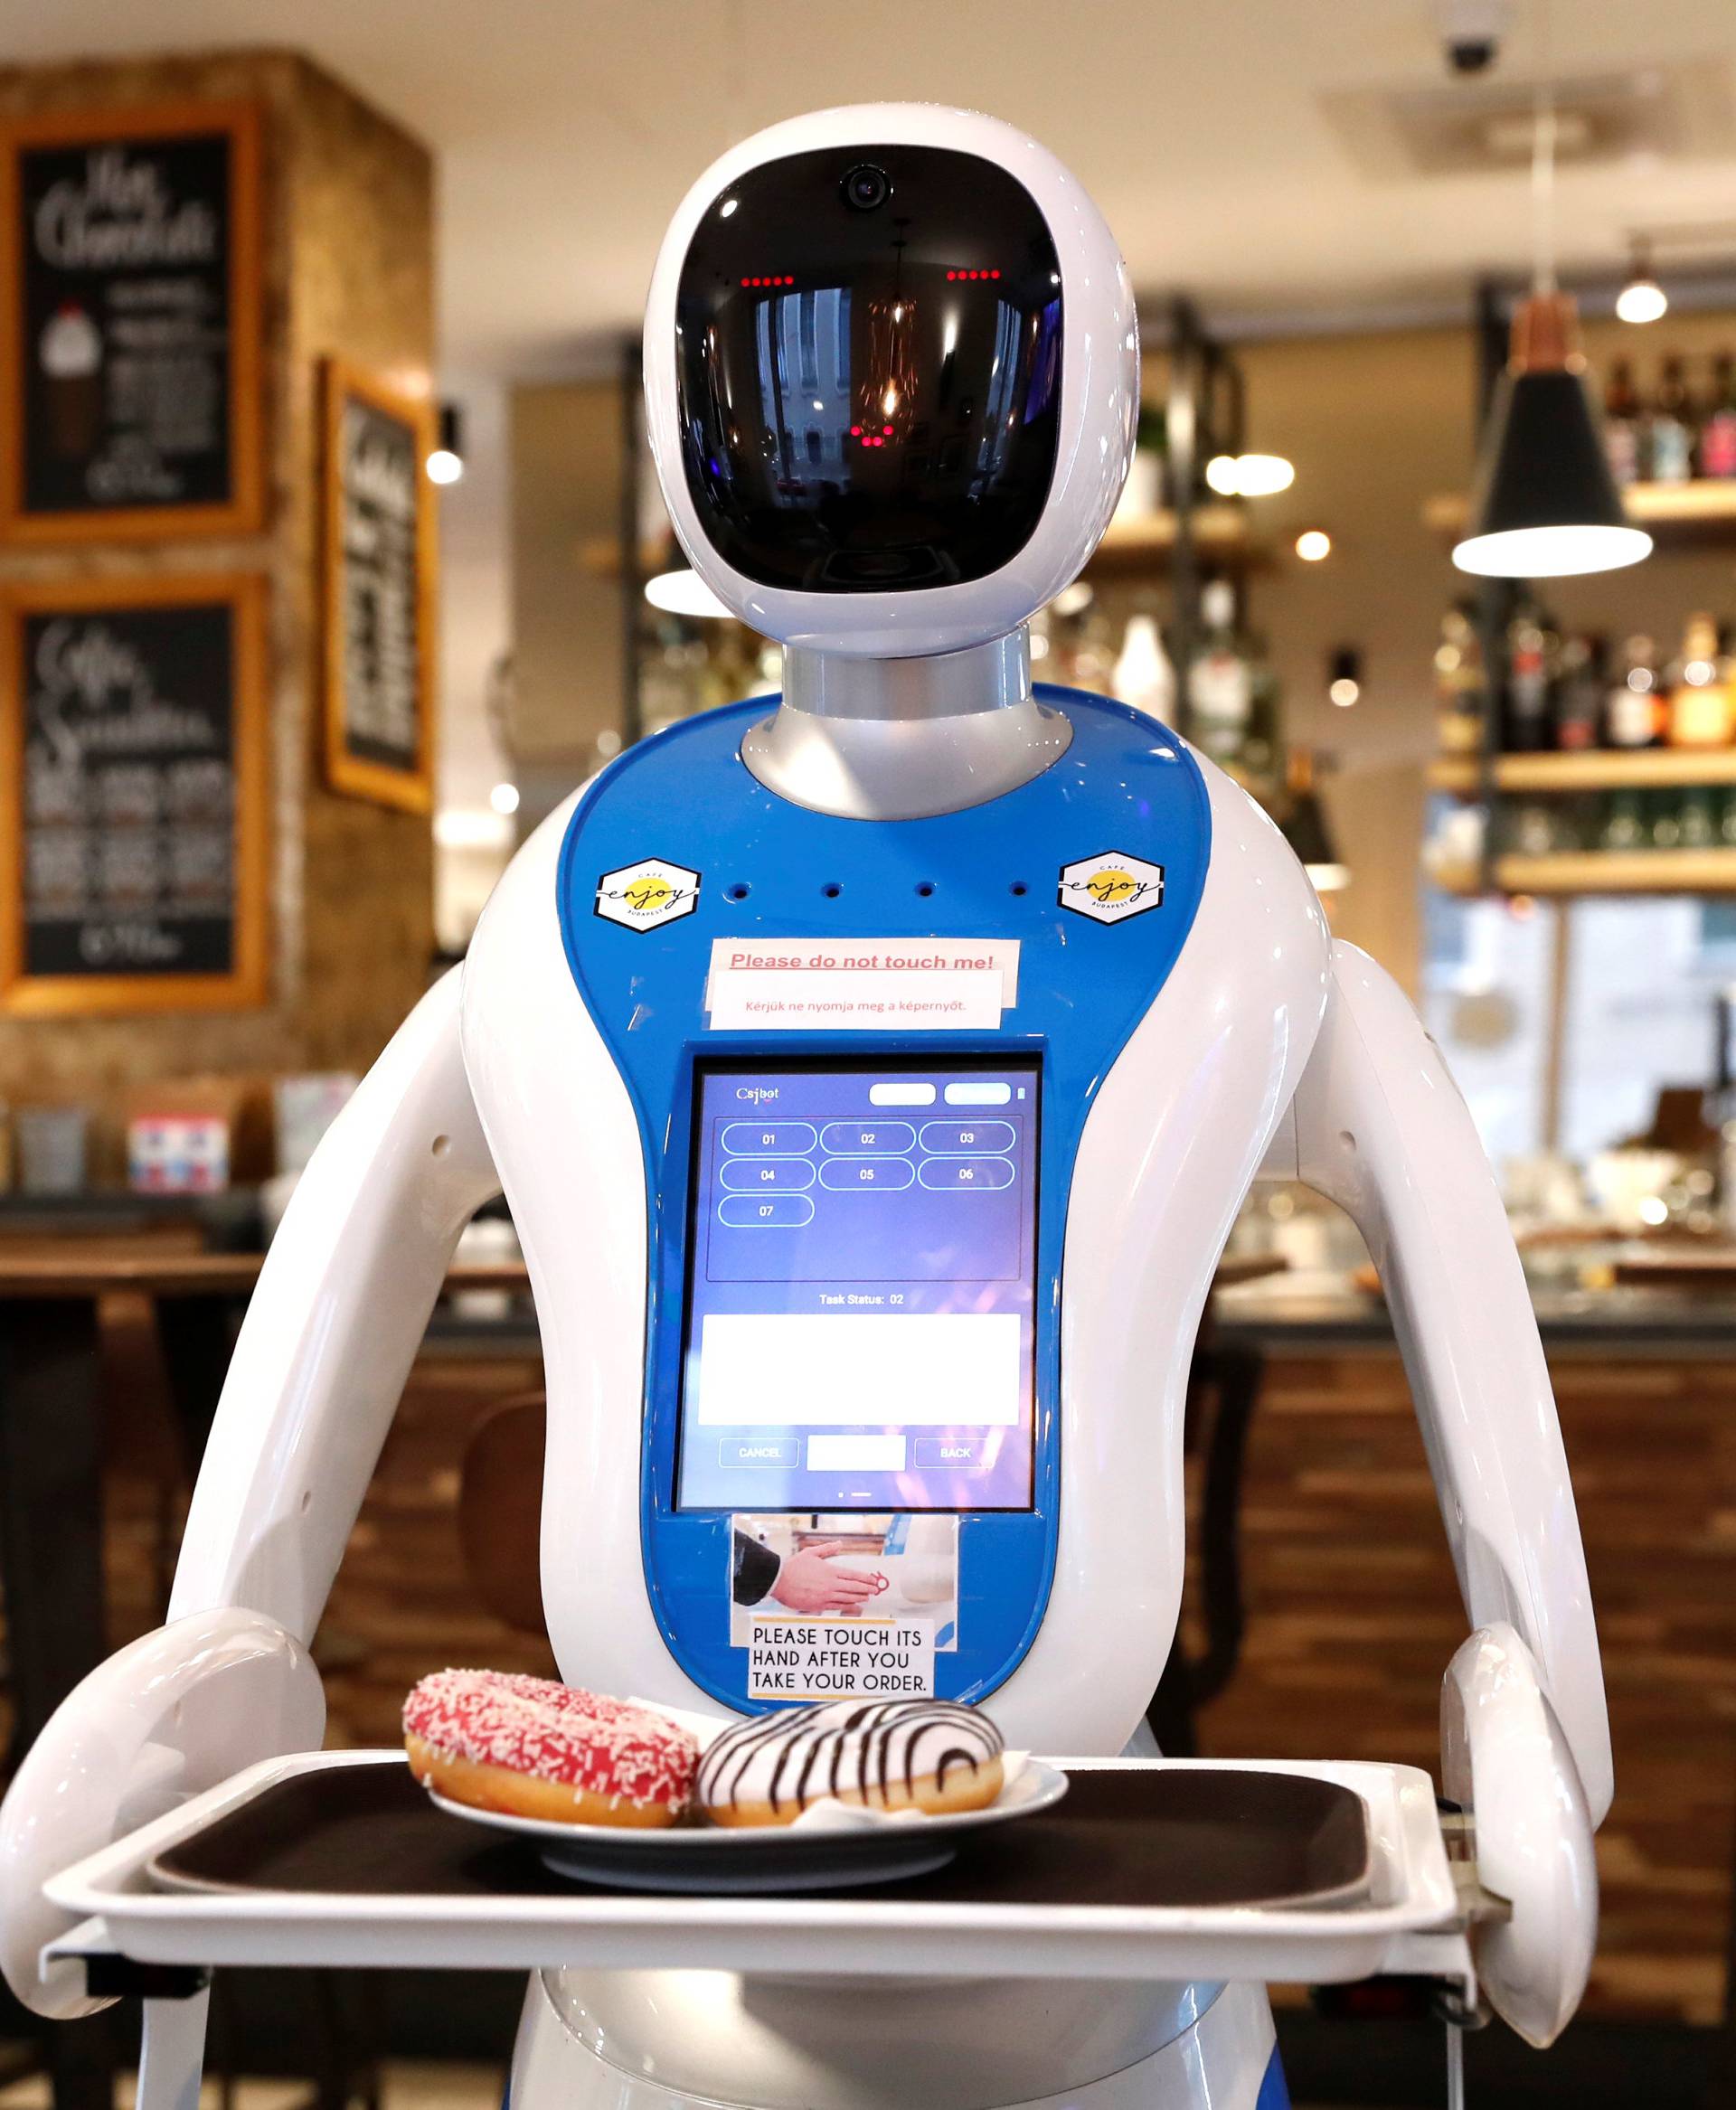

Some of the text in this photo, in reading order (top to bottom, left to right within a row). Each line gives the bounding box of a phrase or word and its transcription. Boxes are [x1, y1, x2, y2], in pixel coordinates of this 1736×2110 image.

[1058, 878, 1161, 902] enjoy
[596, 886, 697, 909] enjoy
[1091, 901, 1128, 909] BUDAPEST
[627, 909, 663, 917] BUDAPEST
[731, 954, 994, 969] Please do not touch me!
[745, 1000, 967, 1013] Kérjük ne nyomja meg a képernyőt.
[736, 1088, 779, 1105] Csjbot
[762, 1135, 776, 1145] 01
[861, 1135, 875, 1145] 02
[959, 1133, 974, 1144] 03
[760, 1170, 775, 1181] 04
[859, 1169, 873, 1180] 05
[958, 1169, 973, 1179] 06
[759, 1206, 774, 1217] 07
[819, 1294, 904, 1305] Task Status: 02
[739, 1447, 782, 1459] CANCEL
[939, 1447, 971, 1459] BACK
[753, 1627, 922, 1647] PLEASE TOUCH ITS
[752, 1650, 910, 1669] HAND AFTER YOU
[752, 1672, 927, 1691] TAKE YOUR ORDER.
